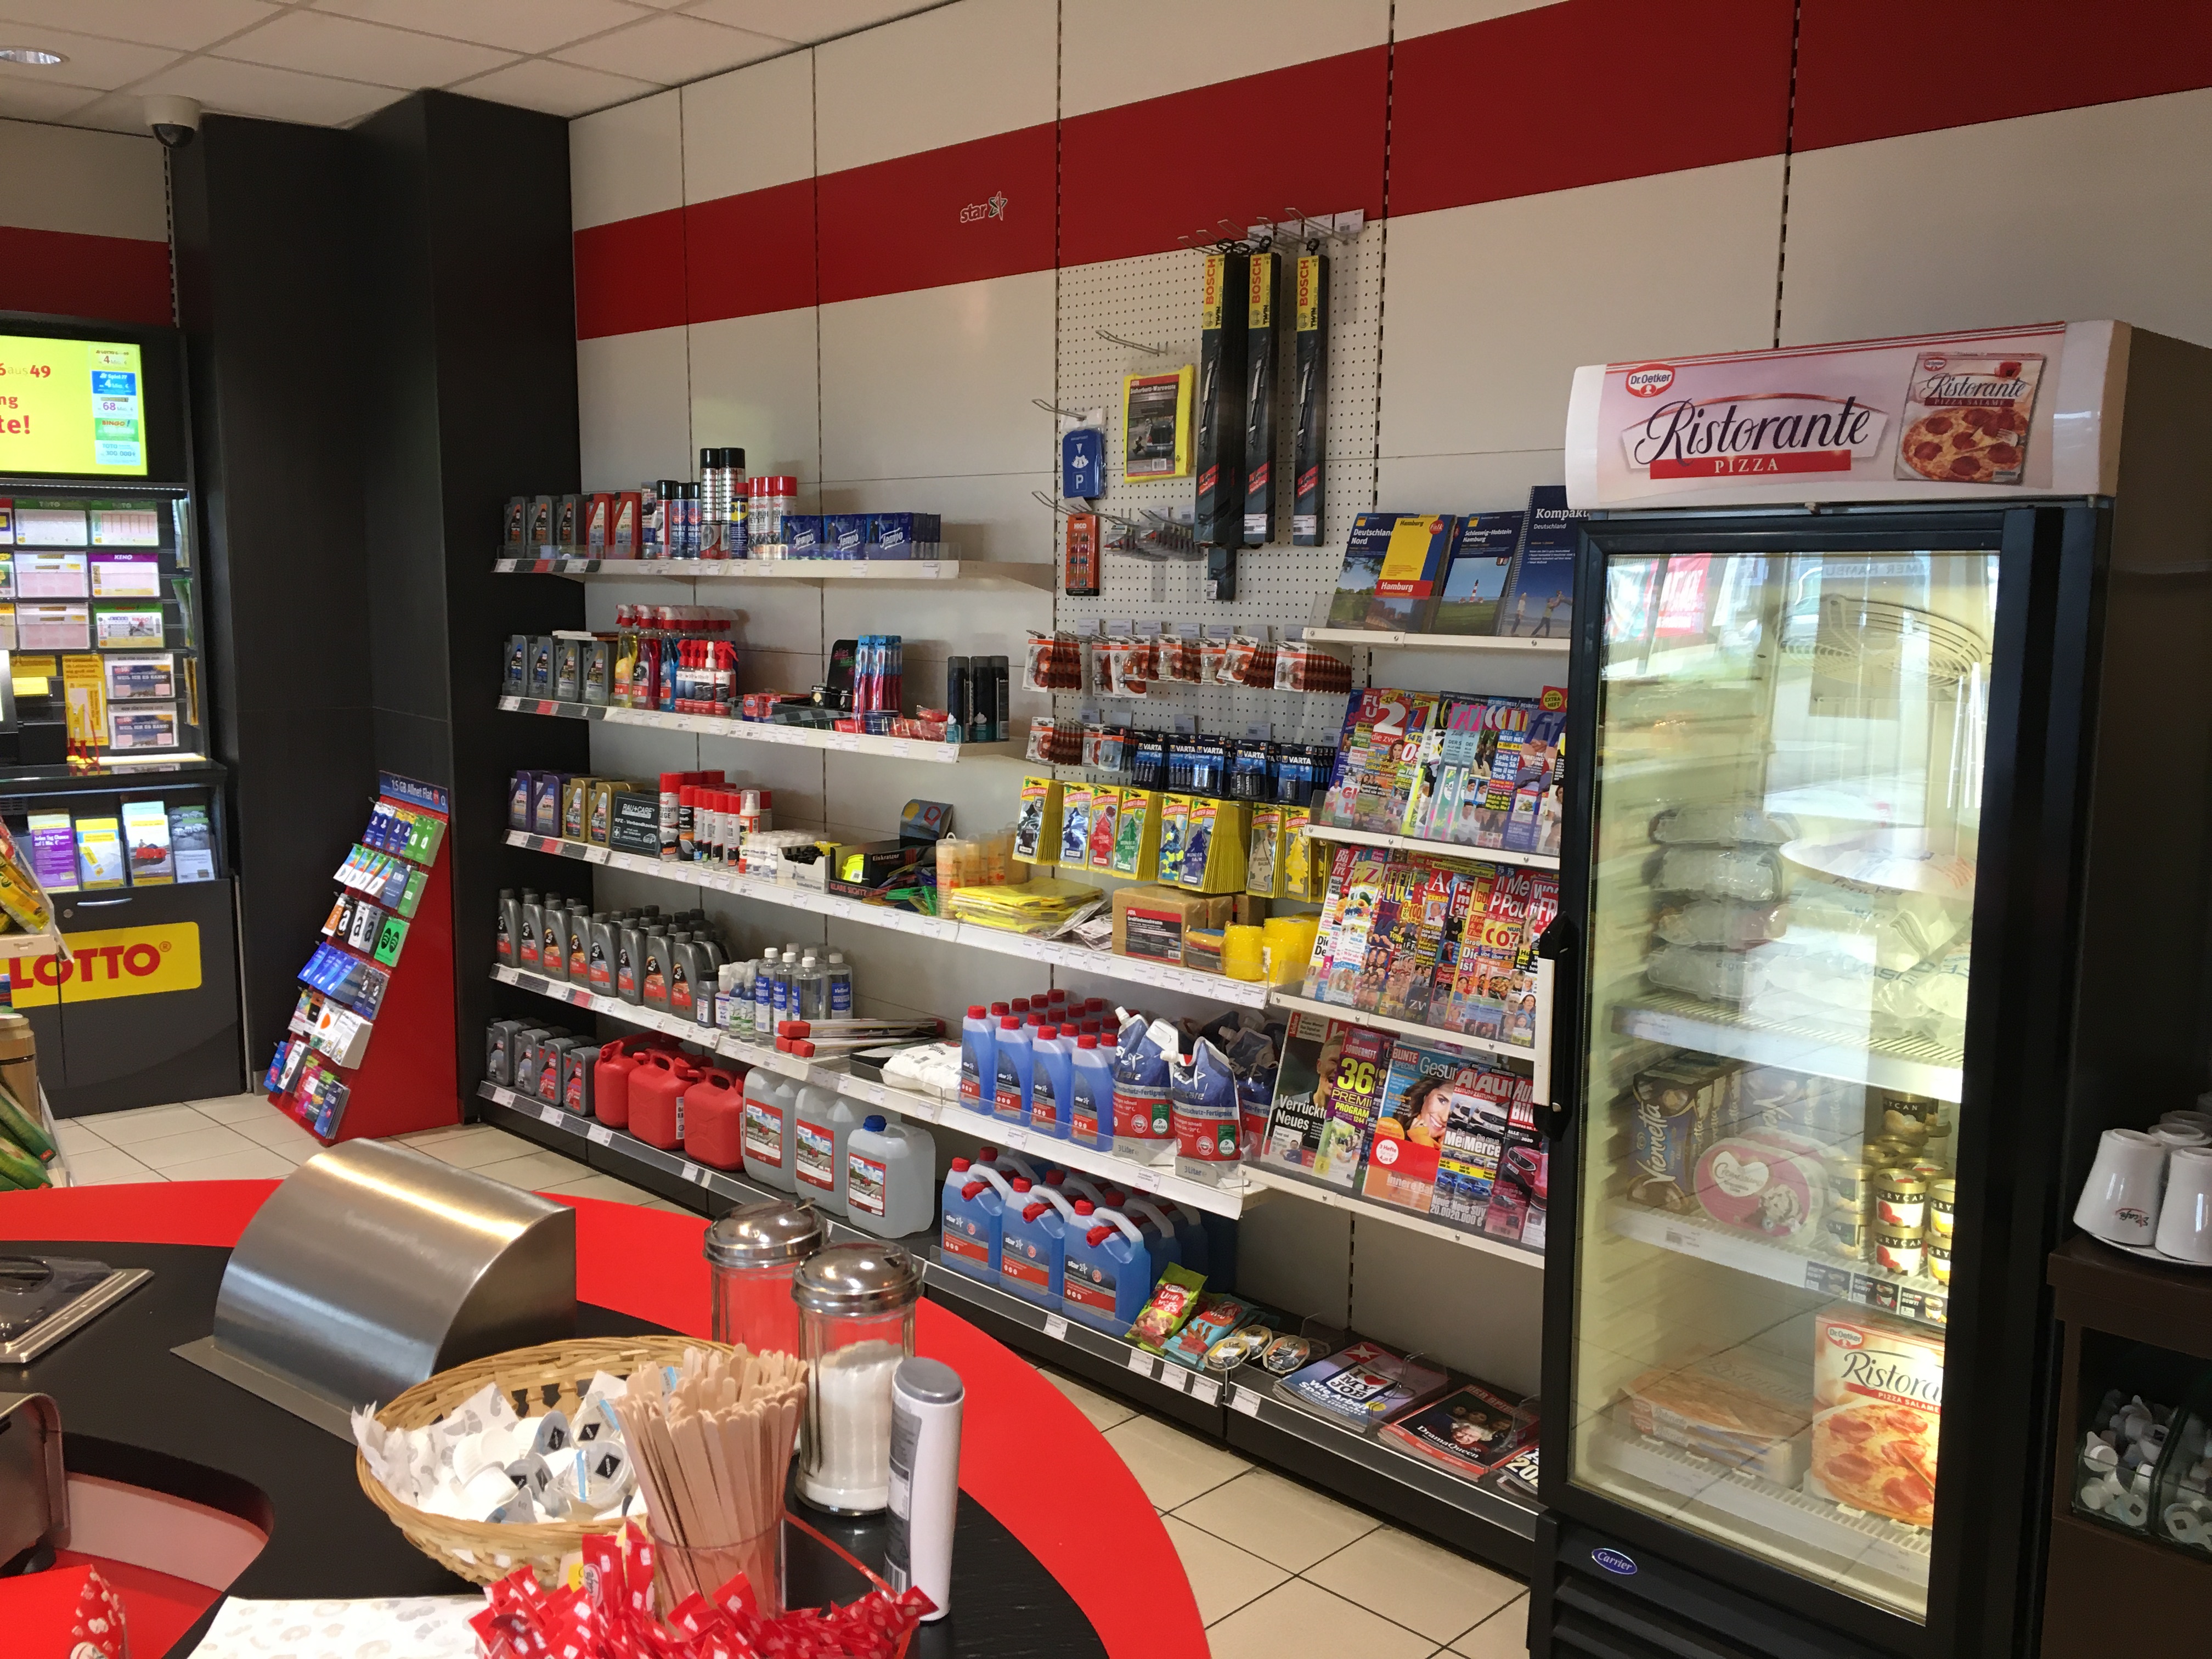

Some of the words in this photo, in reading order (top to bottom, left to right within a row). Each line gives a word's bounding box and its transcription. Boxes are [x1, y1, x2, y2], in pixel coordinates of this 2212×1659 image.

[960, 204, 987, 223] star
[1206, 258, 1216, 304] BOSCH
[1251, 257, 1262, 303] BOSCH
[1300, 259, 1309, 307] BOSCH
[1919, 373, 2026, 400] Ristorante
[103, 402, 116, 410] 68
[1634, 394, 1870, 467] Ristorante
[1714, 459, 1779, 474] PIZZA
[1075, 475, 1084, 490] P
[1430, 523, 1444, 531] Falk
[1465, 528, 1512, 537] Schleswig-Holstein
[1351, 537, 1368, 545] Nord
[1463, 535, 1486, 543] Hamburg
[1381, 582, 1413, 592] Hamburg
[1243, 751, 1265, 759] VARTA
[872, 853, 900, 861] Eiskratzer
[830, 882, 847, 892] KLARE
[9, 943, 161, 990] LOTTO
[1460, 960, 1474, 972] ist
[1345, 1044, 1377, 1059] SONDERHEFT
[1392, 1048, 1419, 1064] BUNTE
[1395, 1062, 1416, 1071] SPECIAL
[1473, 1091, 1497, 1101] ZEITUNG
[1276, 1109, 1310, 1130] Neues
[1486, 1136, 1499, 1144] neue
[1636, 1102, 1677, 1187] Viennetta
[1122, 1146, 1135, 1154] Liter
[1188, 1166, 1201, 1176] Liter
[1387, 1173, 1417, 1189] Innere
[1880, 1191, 1925, 1203] GRYCAN
[1453, 1200, 1469, 1214] Neue
[1471, 1205, 1487, 1217] SUV
[946, 1215, 956, 1223] star
[1005, 1237, 1015, 1245] star
[1877, 1237, 1922, 1248] GRYCAN
[1068, 1260, 1079, 1269] star
[1330, 1381, 1367, 1398] JOB
[1340, 1375, 1376, 1392] MY
[1310, 1380, 1331, 1395] Wie
[1331, 1391, 1368, 1410] Arbeit
[1468, 1385, 1487, 1399] DER
[1878, 1391, 1902, 1404] PIZZA
[1417, 1425, 1479, 1459] DramaQueen
[1596, 1551, 1634, 1572] Carrier
